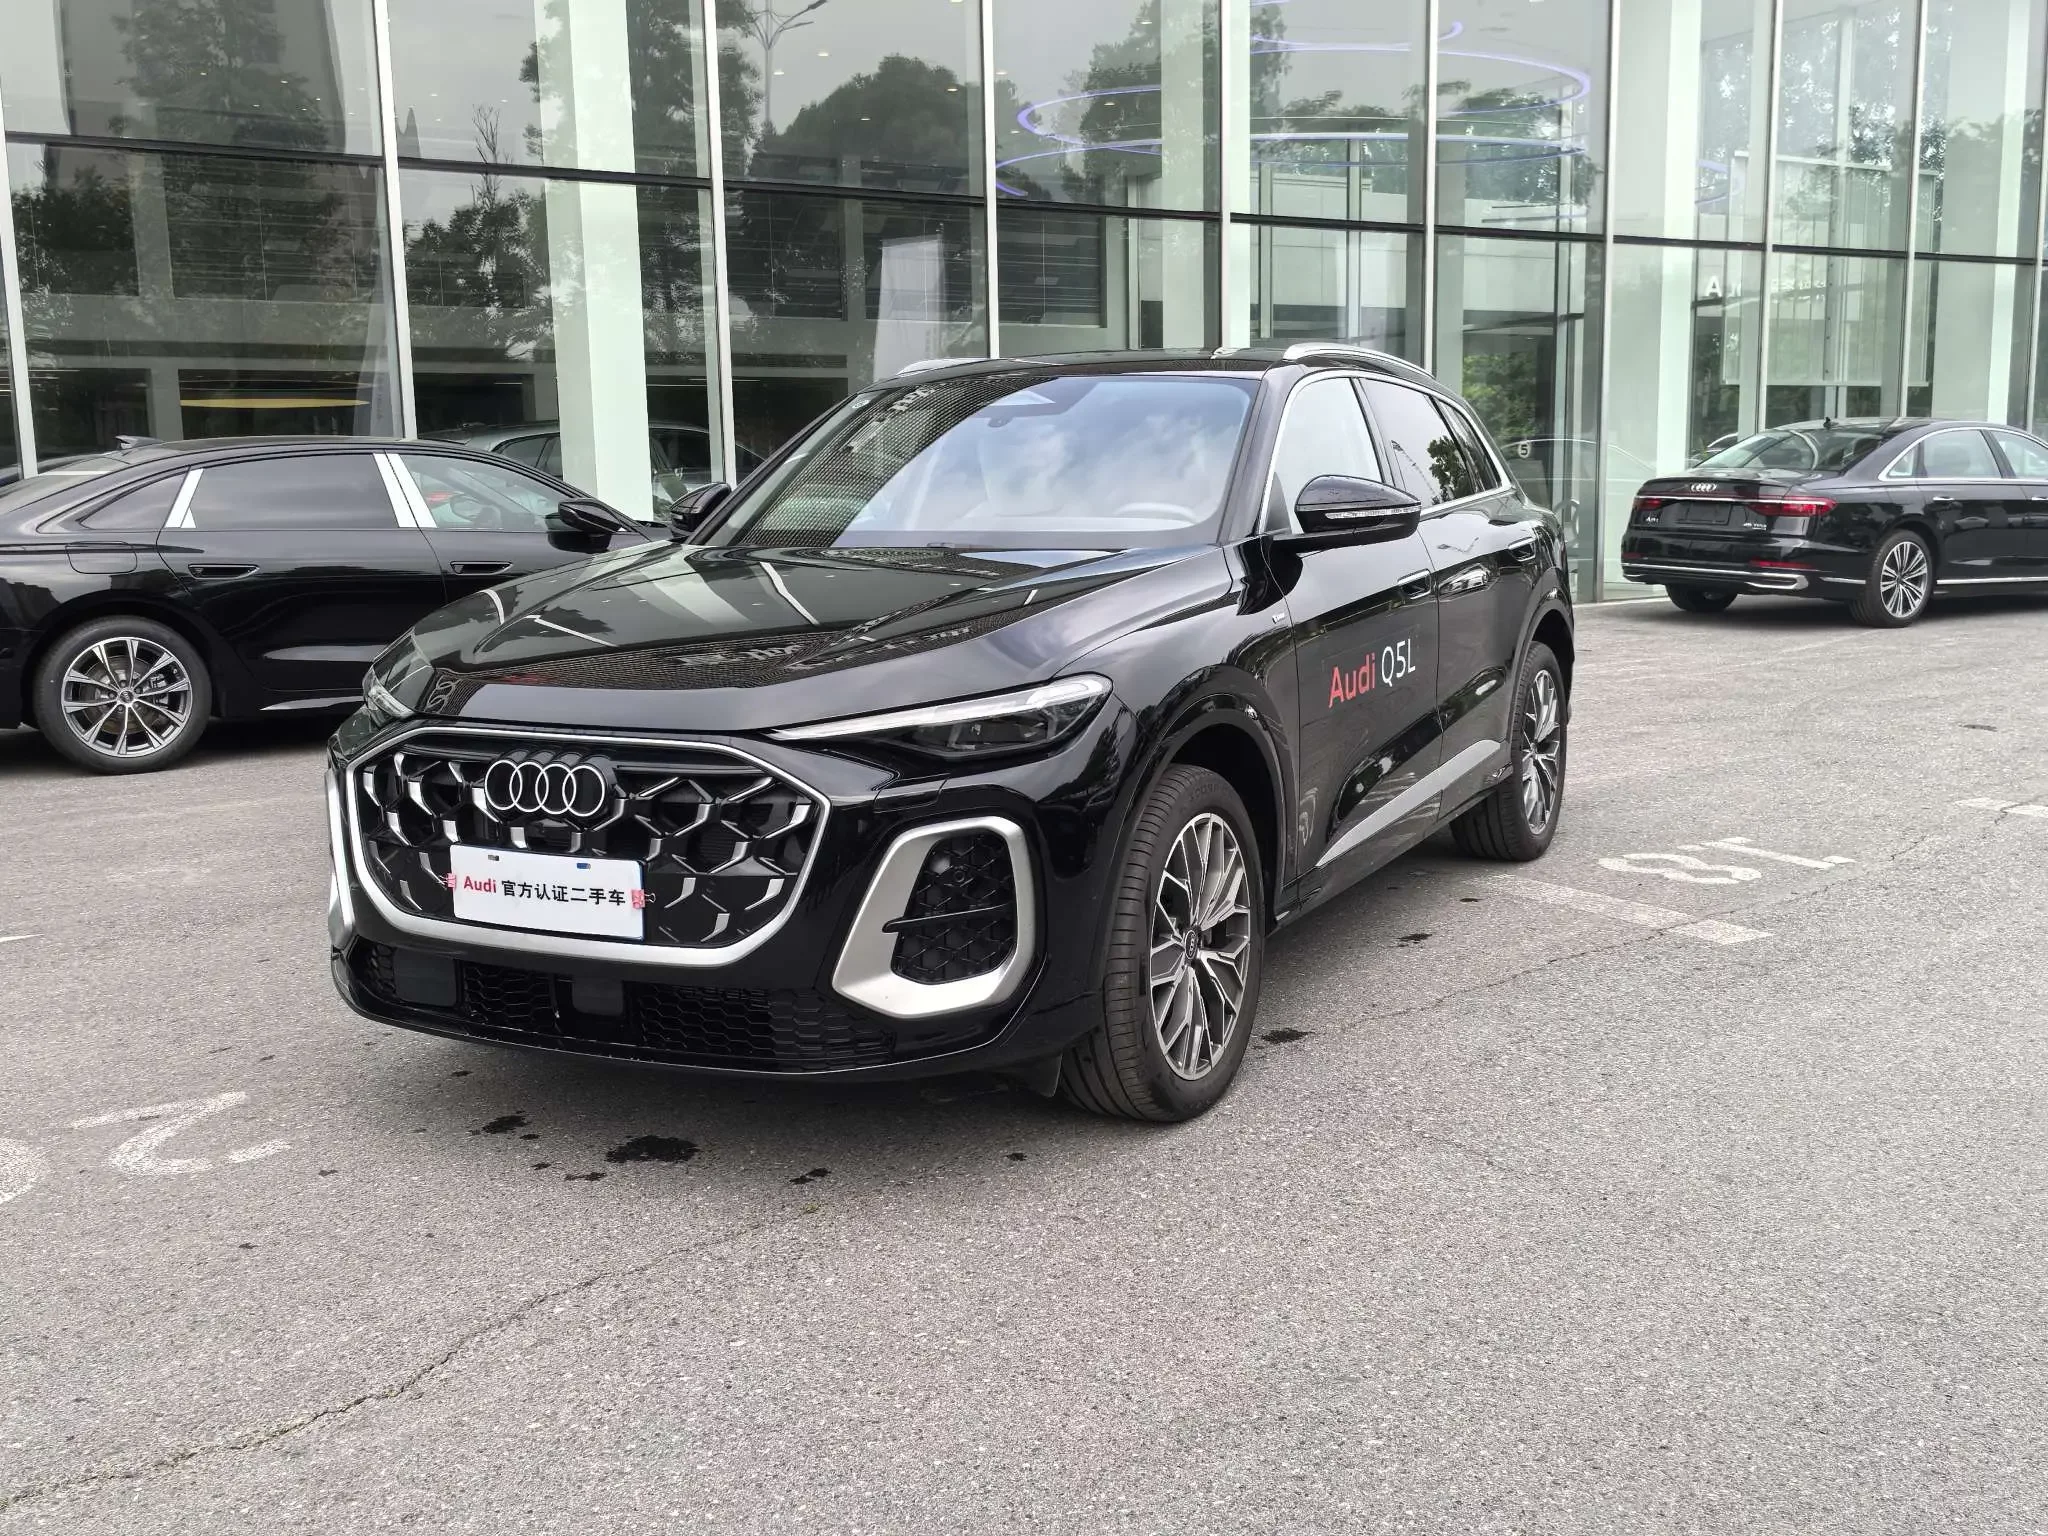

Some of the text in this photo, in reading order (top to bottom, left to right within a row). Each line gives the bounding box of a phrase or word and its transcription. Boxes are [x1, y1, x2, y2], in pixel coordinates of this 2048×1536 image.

[1328, 638, 1416, 709] Audi Q5L
[463, 875, 627, 906] Audi 官方认证二手车
